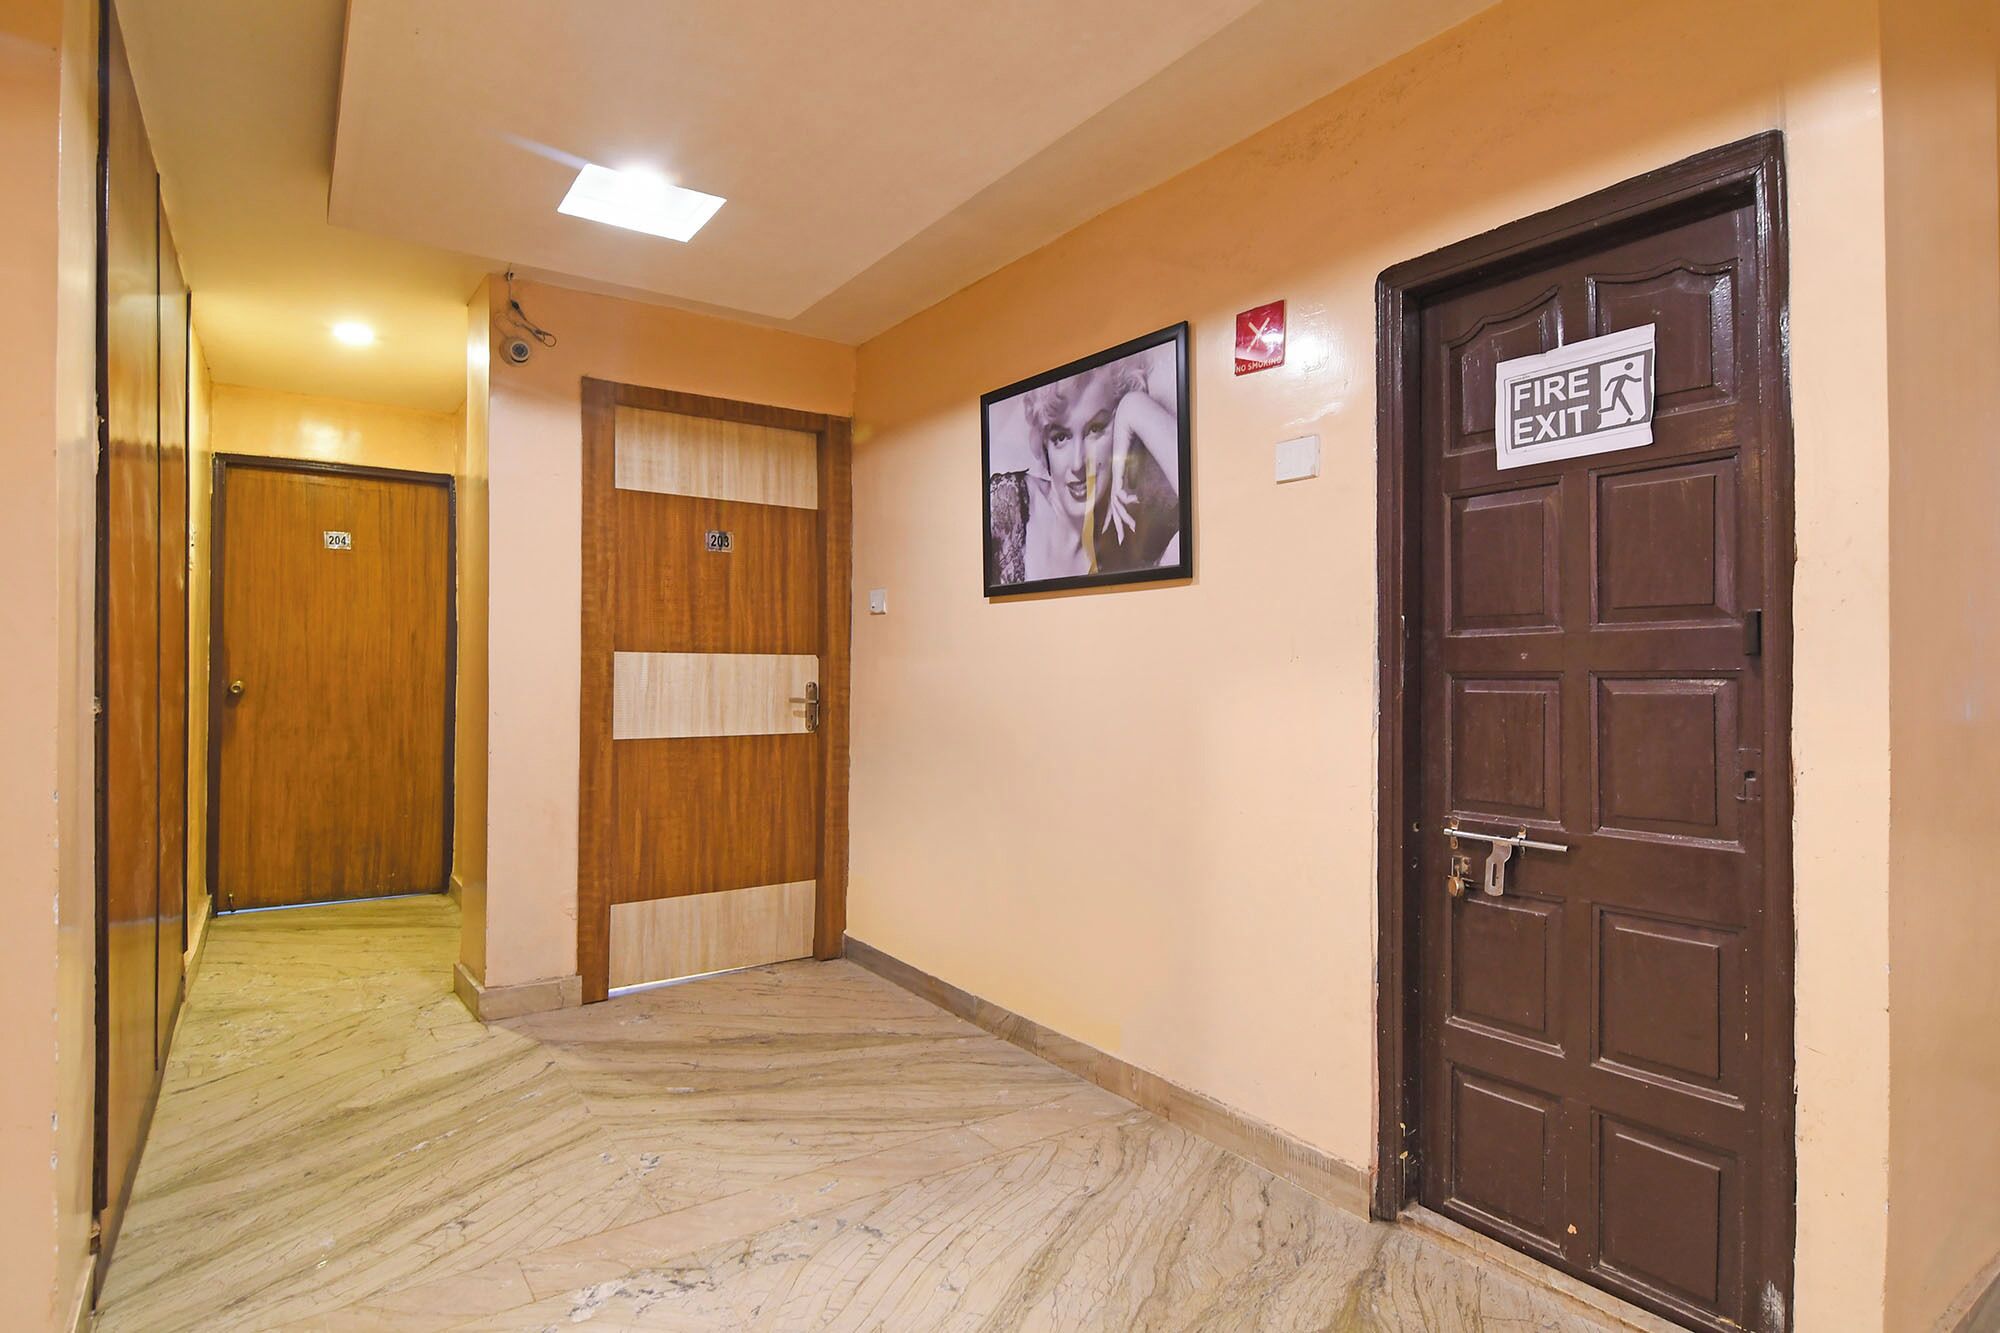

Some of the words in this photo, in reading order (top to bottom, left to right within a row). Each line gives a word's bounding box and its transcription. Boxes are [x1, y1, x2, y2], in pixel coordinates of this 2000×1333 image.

[1248, 357, 1282, 370] SMOKING
[1513, 368, 1590, 412] FIRE
[1514, 404, 1589, 446] EXIT
[328, 535, 347, 545] 204
[710, 534, 730, 548] 203
